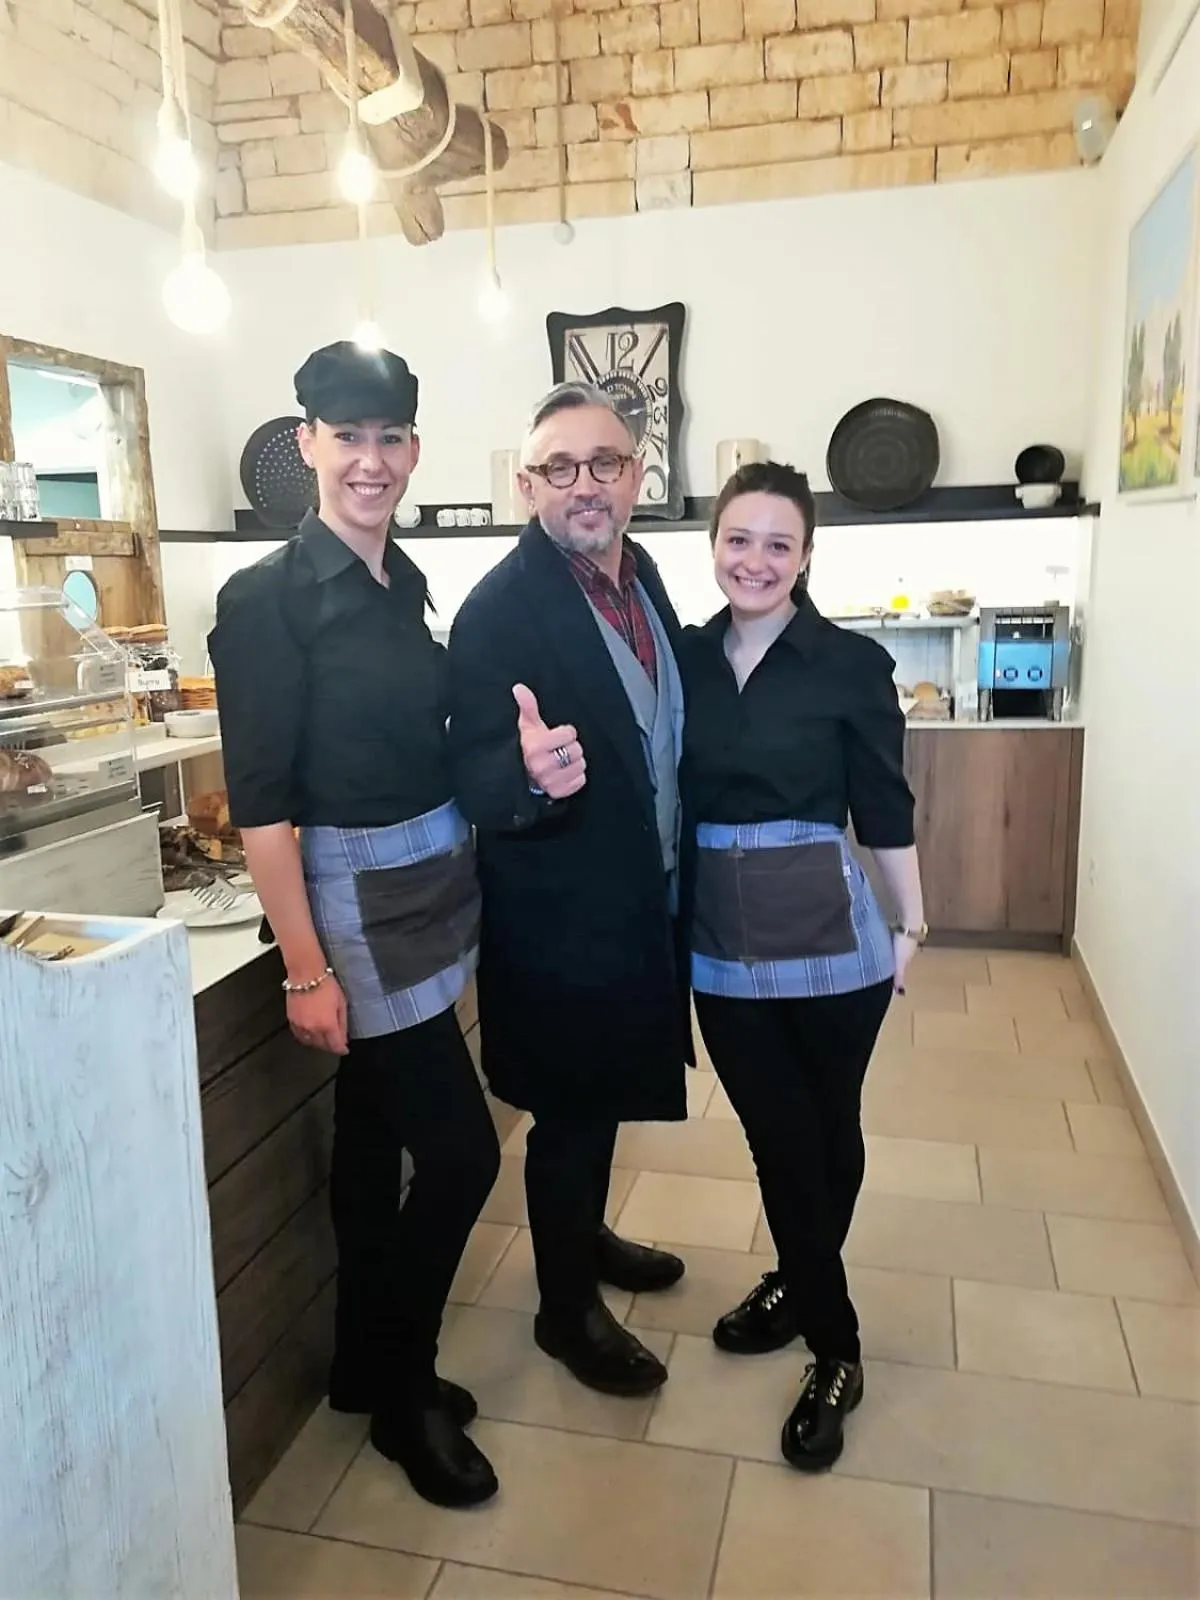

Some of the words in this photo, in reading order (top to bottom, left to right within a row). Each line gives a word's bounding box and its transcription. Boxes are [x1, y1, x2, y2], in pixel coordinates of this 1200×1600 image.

[606, 331, 639, 372] 12
[646, 377, 668, 403] 2
[653, 405, 668, 424] 3
[645, 432, 668, 461] 4
